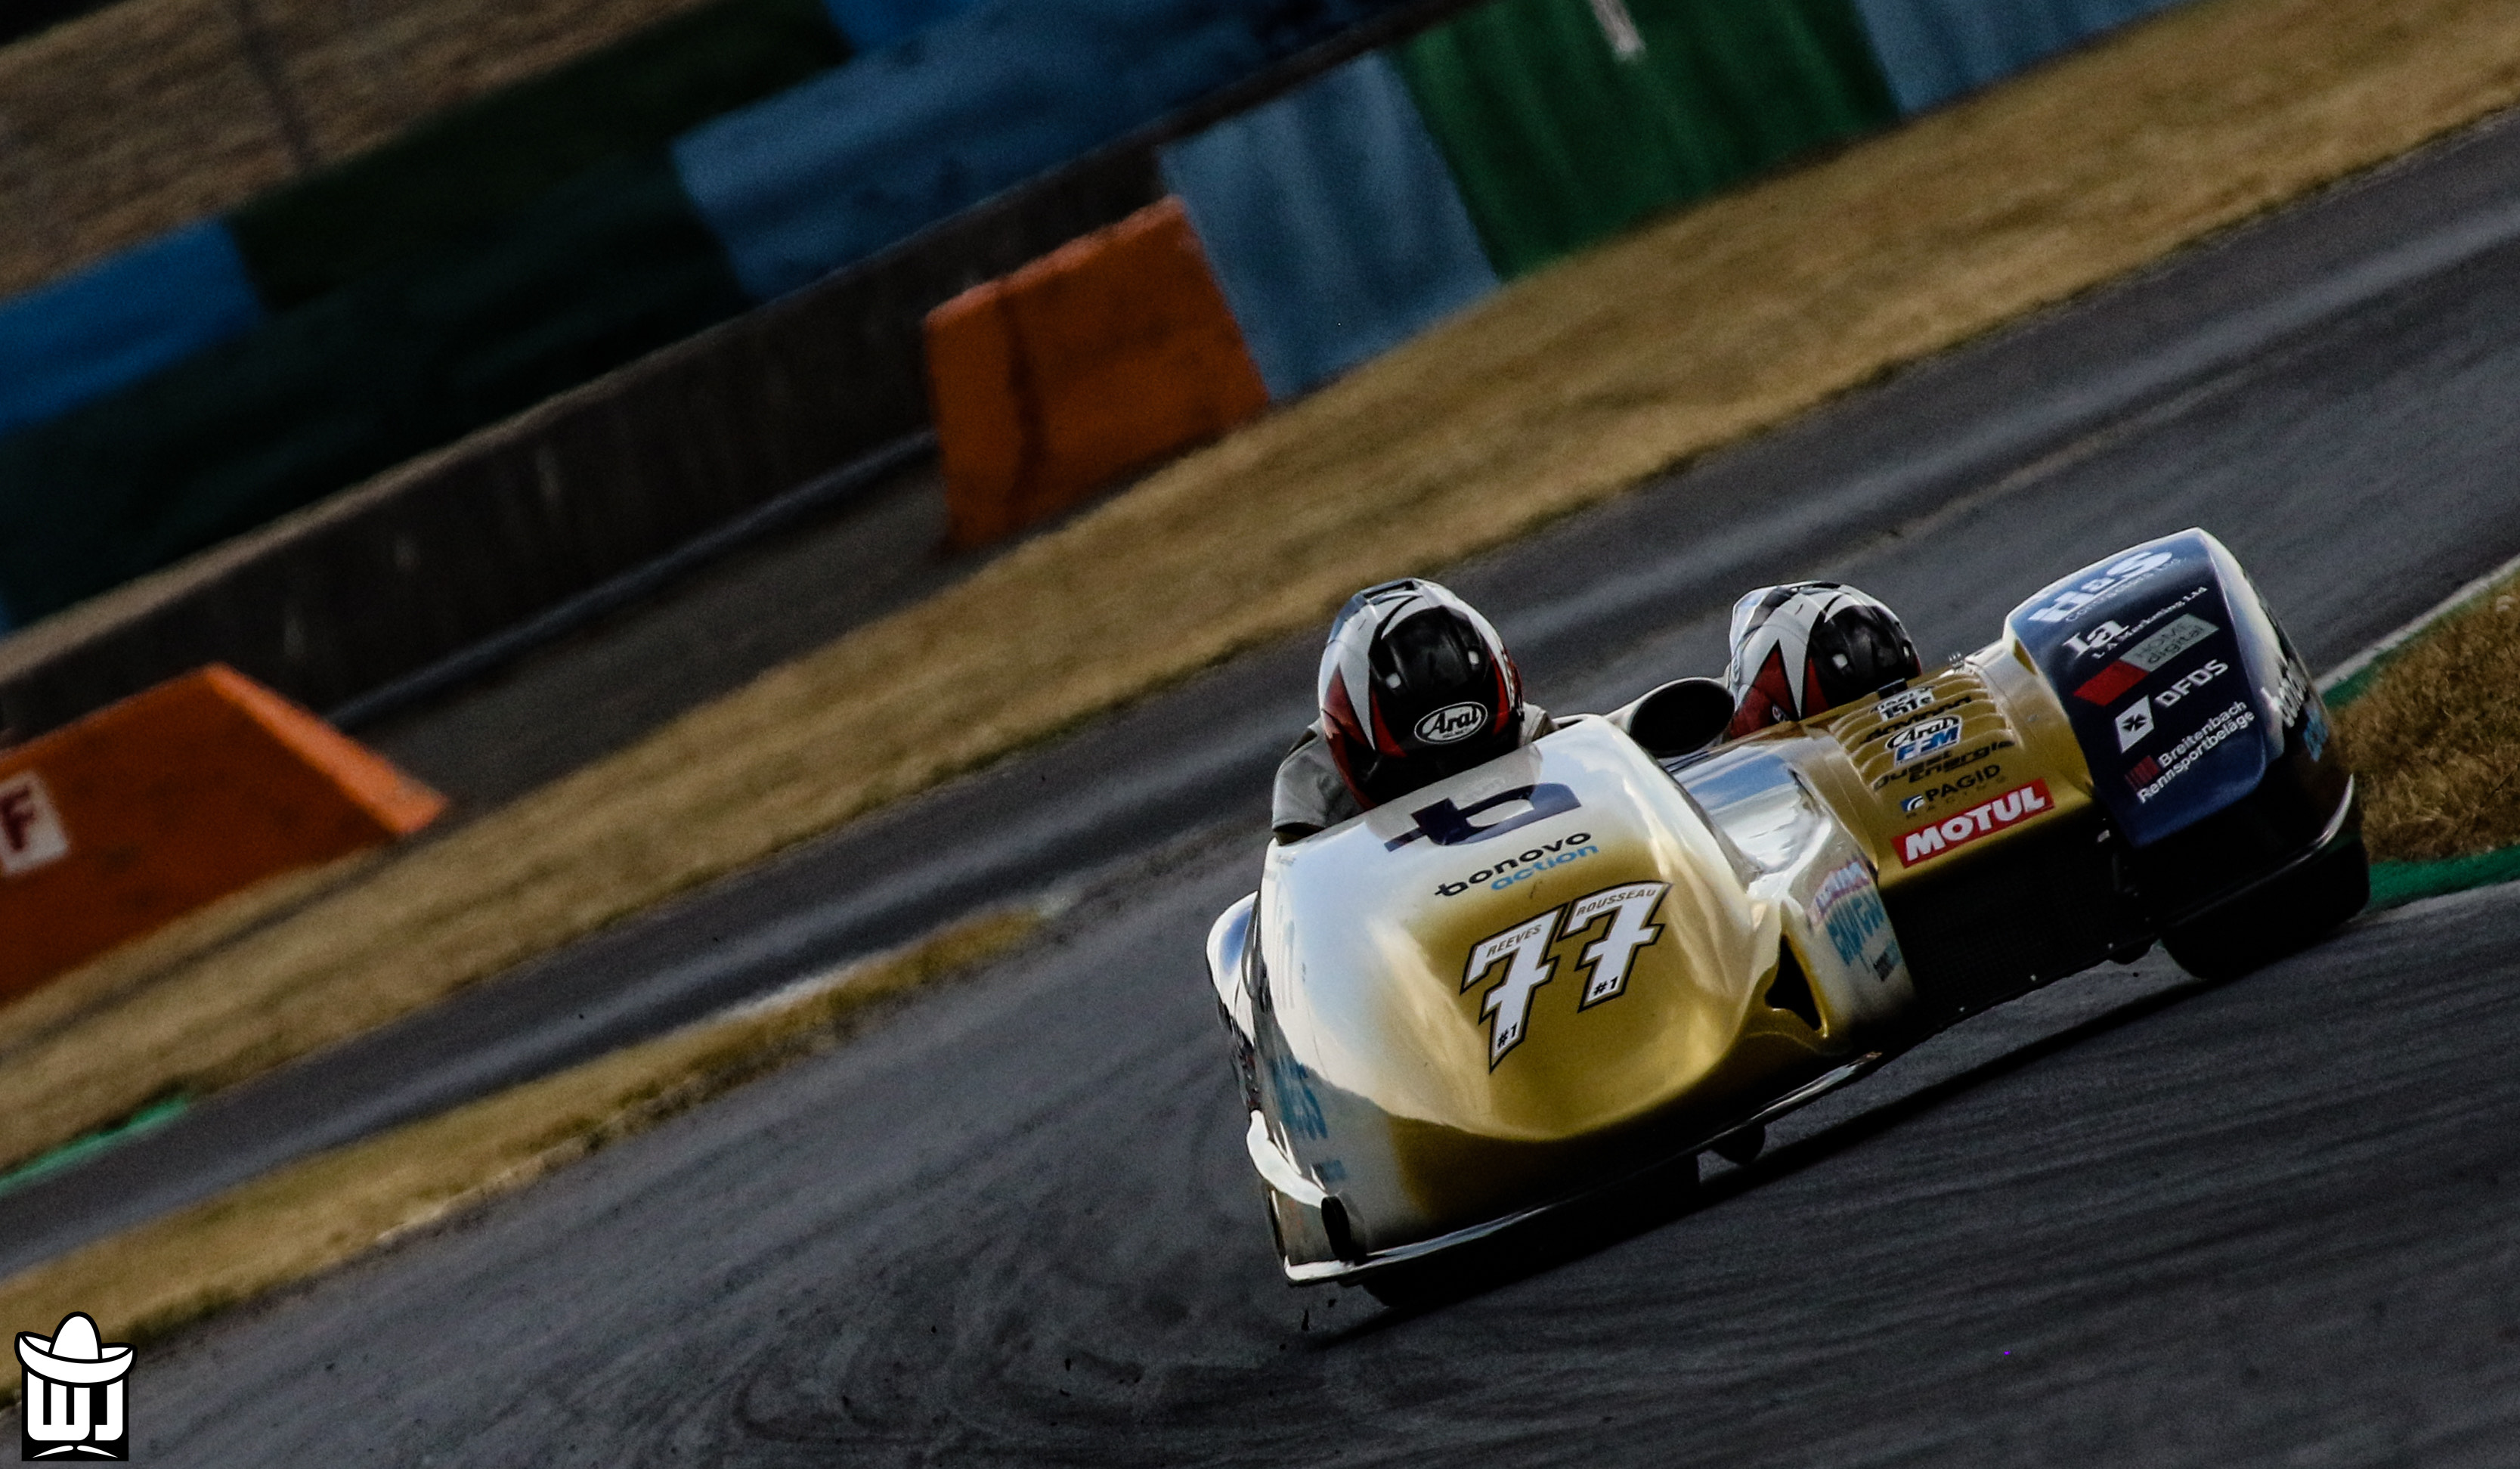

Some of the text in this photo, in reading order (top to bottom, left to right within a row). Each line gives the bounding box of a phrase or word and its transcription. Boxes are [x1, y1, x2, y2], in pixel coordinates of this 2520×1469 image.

[2154, 659, 2228, 708] DFDS
[1423, 705, 1481, 739] Arai
[2158, 701, 2247, 768] Breitenbach
[2136, 711, 2255, 804] Rennsportbeläge
[1925, 764, 2001, 802] PAGID
[1905, 786, 2045, 862] MOTUL
[1435, 832, 1591, 897] bonovo
[1491, 843, 1599, 891] action
[1576, 889, 1656, 916] ROUSSEAU
[1486, 925, 1541, 958] REEVES
[1460, 880, 1673, 1074] 77
[1593, 976, 1618, 996] #1
[1497, 1024, 1519, 1048] #1
